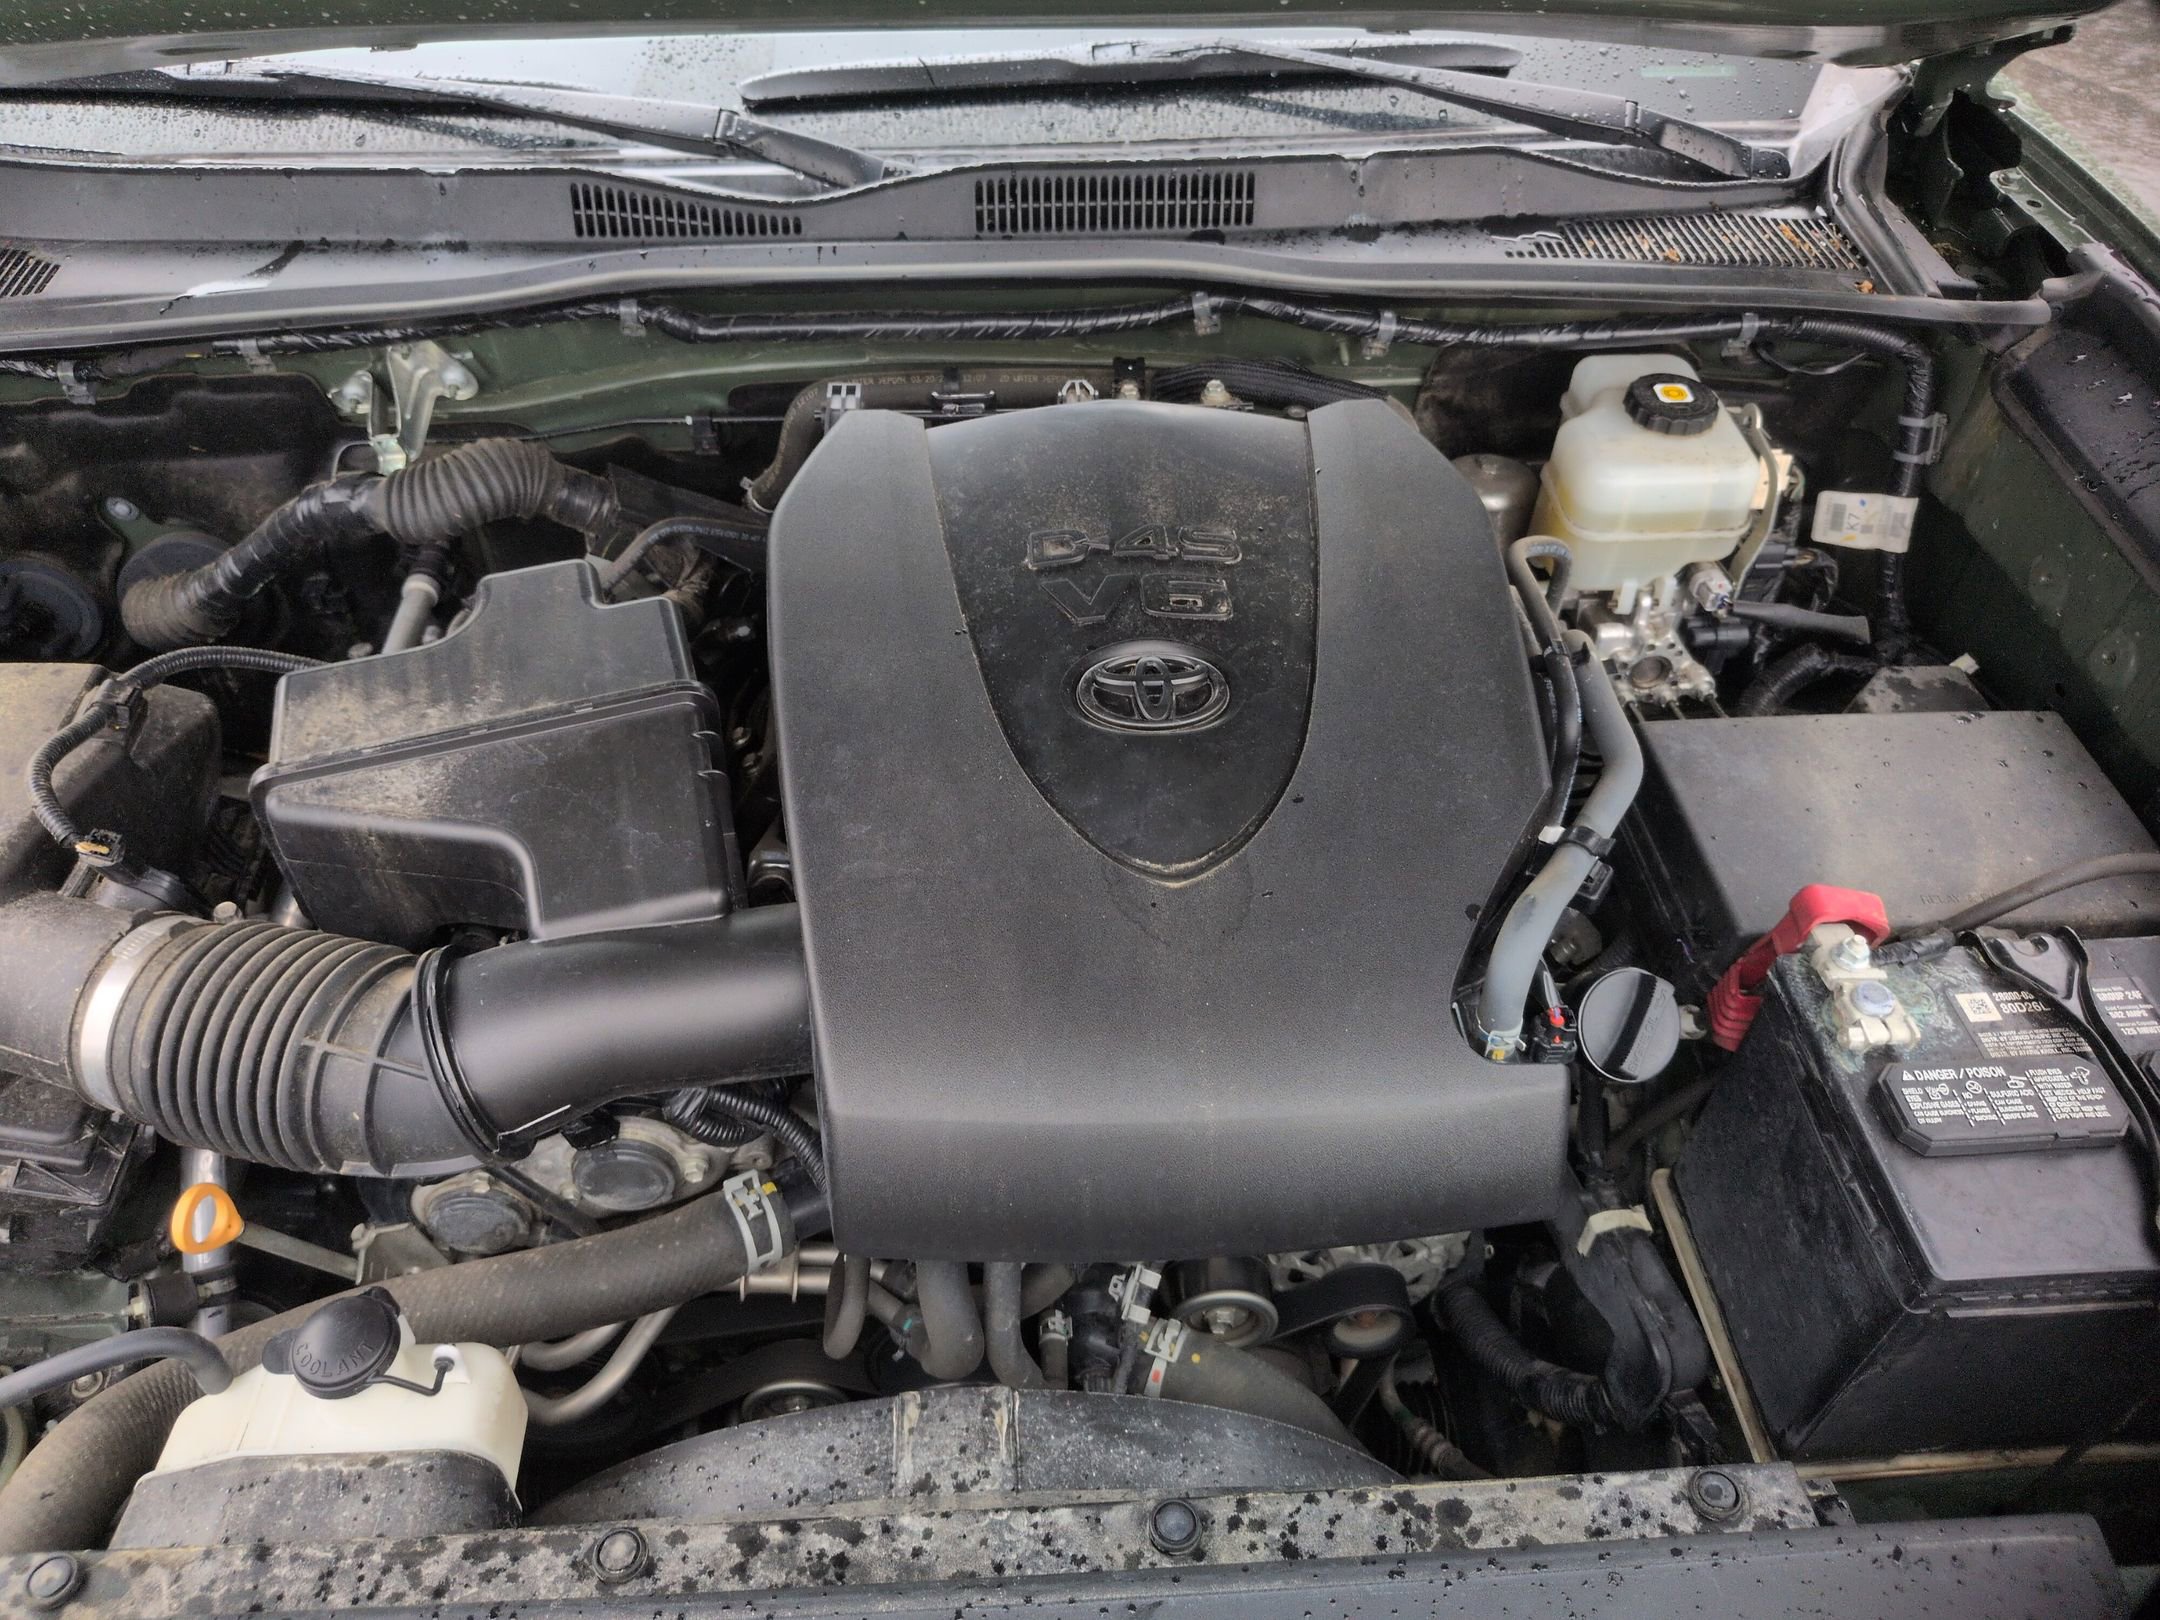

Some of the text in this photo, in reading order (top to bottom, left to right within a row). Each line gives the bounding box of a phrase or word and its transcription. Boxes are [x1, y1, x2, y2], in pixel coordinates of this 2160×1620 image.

[1847, 513, 1861, 531] K7
[1026, 523, 1242, 570] D-4S
[1039, 572, 1234, 625] V6
[1920, 894, 1961, 905] RELAY
[2000, 1001, 2051, 1014] 80D26L
[1913, 1068, 1958, 1081] DANGER
[1965, 1065, 2007, 1079] POISON
[1901, 1087, 1924, 1096] SHIELD
[1961, 1091, 1973, 1100] NO
[1989, 1088, 2035, 1099] SULFURIC ACID
[1904, 1095, 1922, 1103] EYES
[295, 1339, 375, 1379] COOLANT
